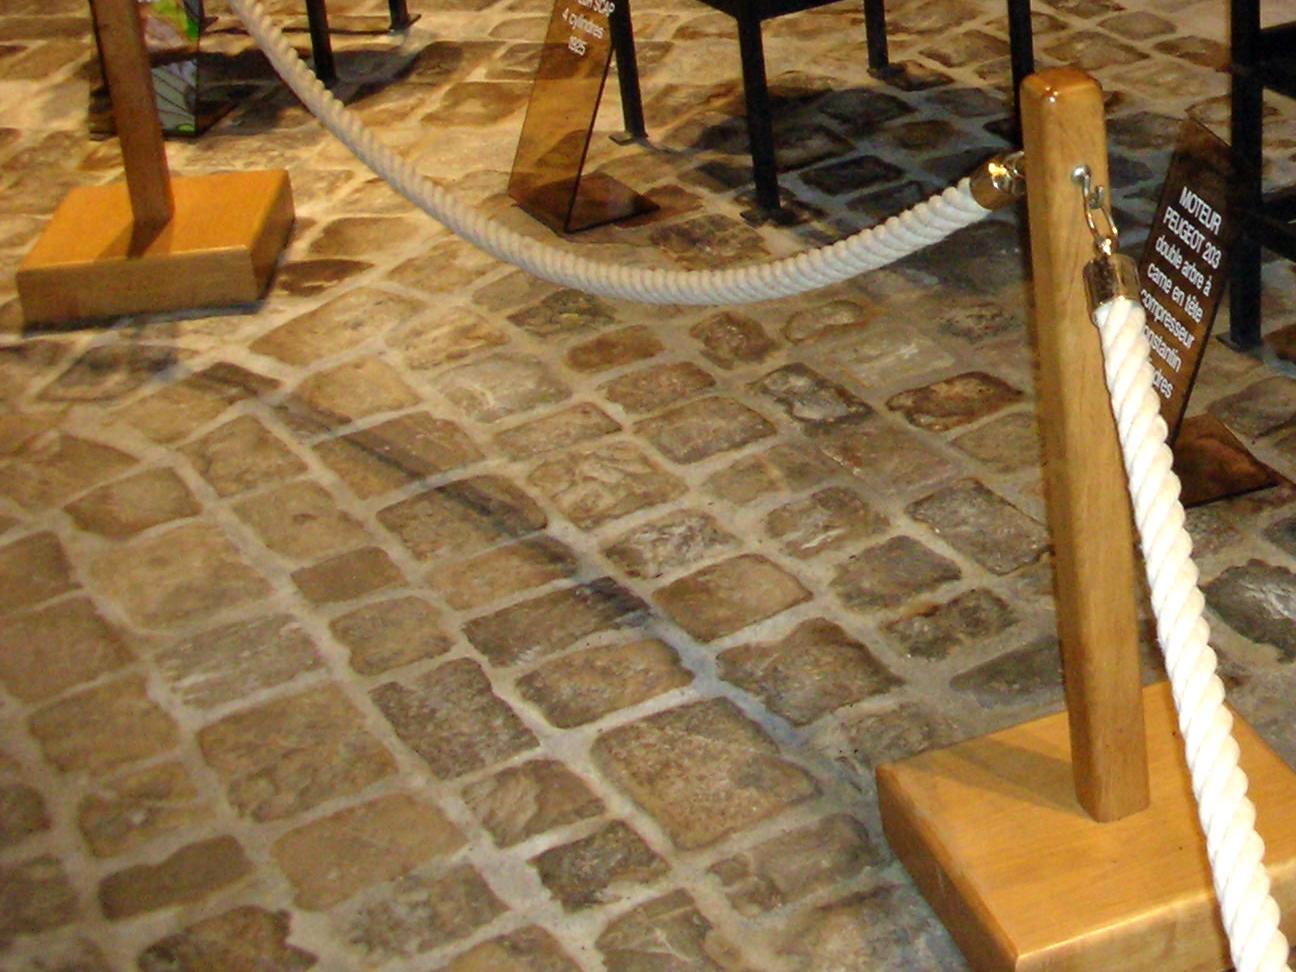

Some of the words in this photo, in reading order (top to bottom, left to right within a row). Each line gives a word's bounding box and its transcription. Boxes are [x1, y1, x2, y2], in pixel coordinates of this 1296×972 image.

[1163, 206, 1207, 255] PEUGEOT
[1202, 241, 1222, 270] 203
[1180, 187, 1222, 236] MOTEUR
[1148, 264, 1171, 296] came
[1172, 286, 1186, 304] en
[1186, 293, 1203, 324] tête
[1156, 234, 1182, 270] double
[1182, 256, 1202, 289] arbre
[1203, 276, 1212, 297] à
